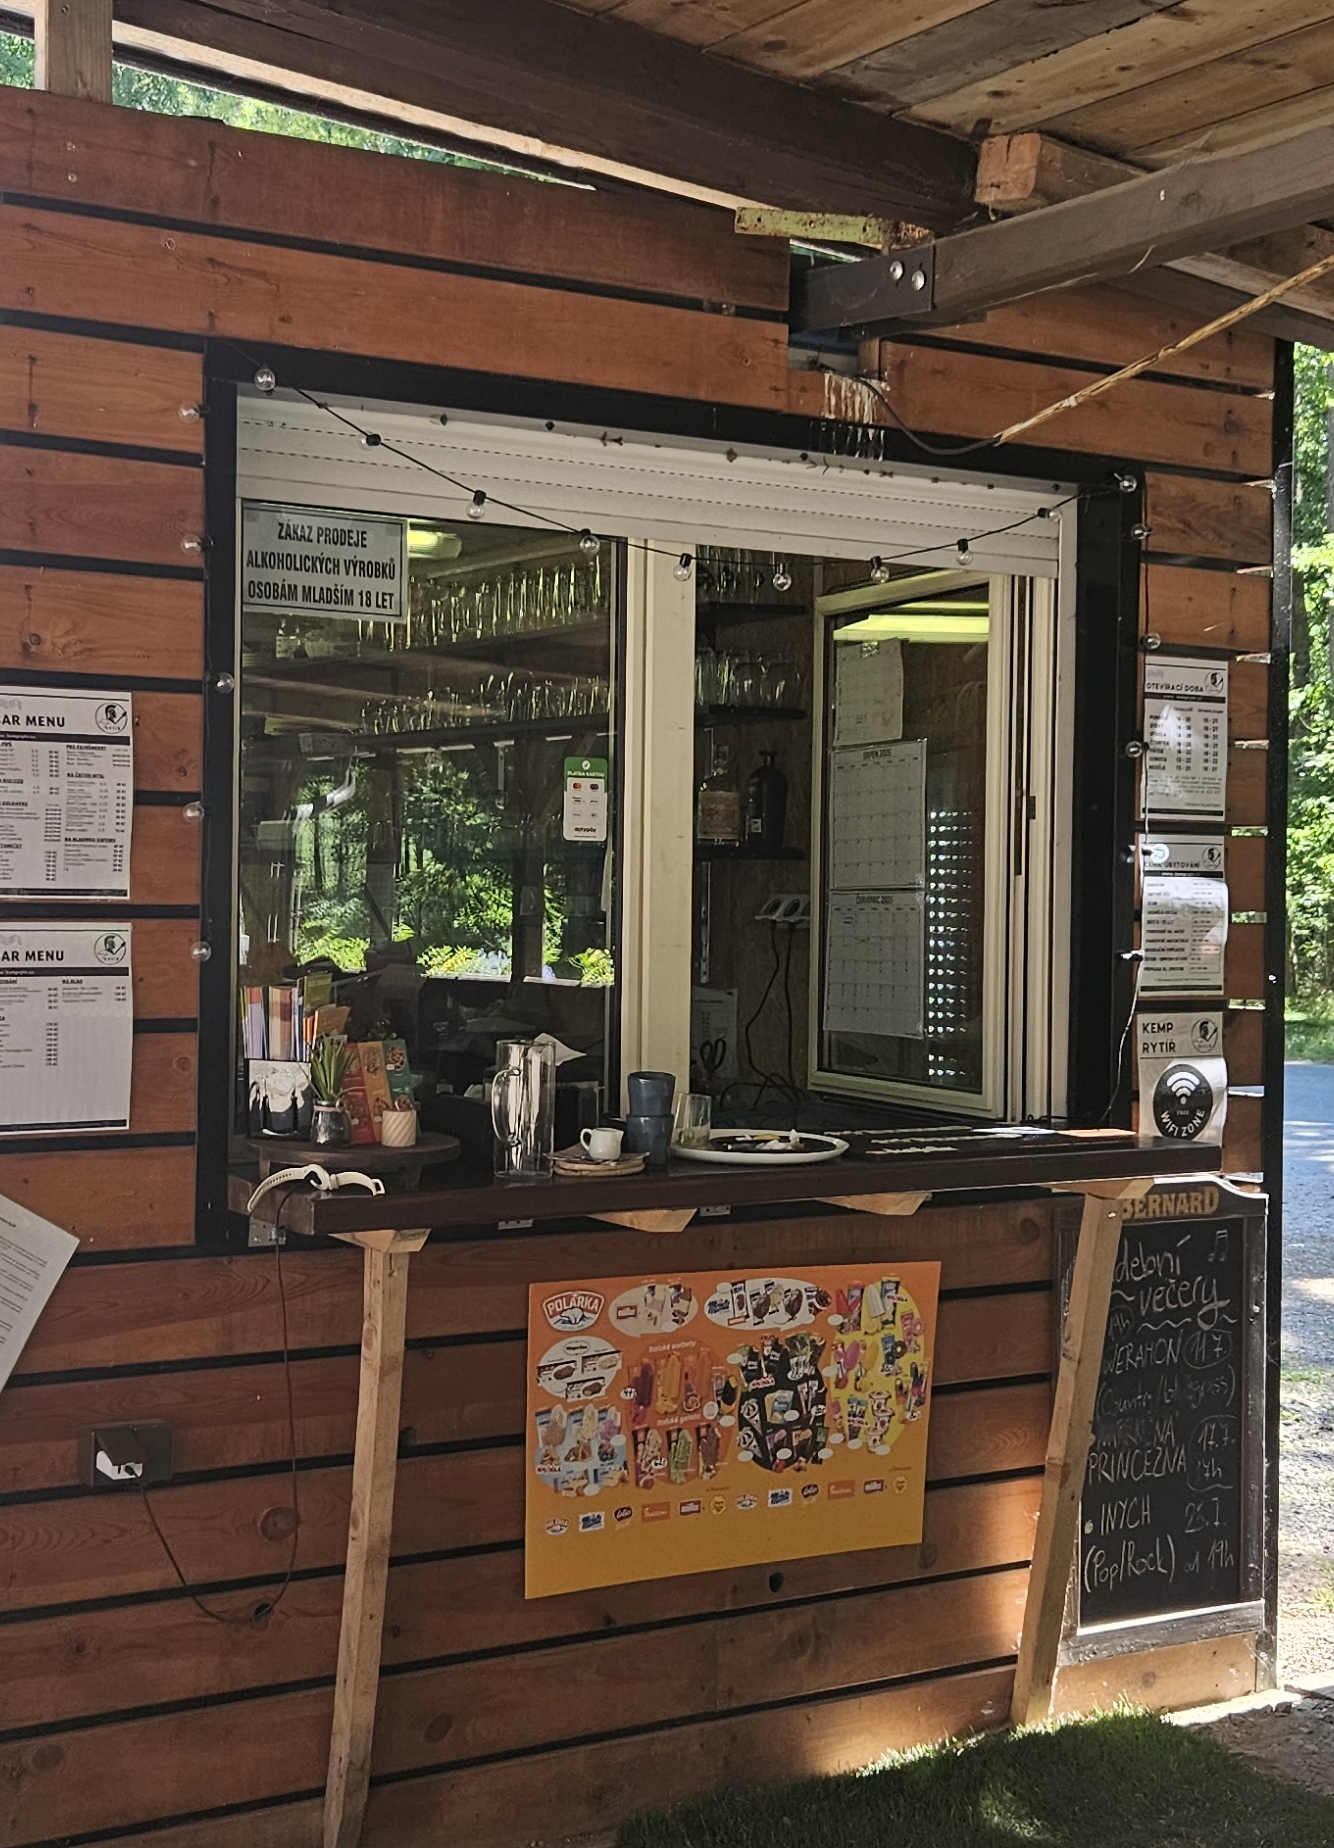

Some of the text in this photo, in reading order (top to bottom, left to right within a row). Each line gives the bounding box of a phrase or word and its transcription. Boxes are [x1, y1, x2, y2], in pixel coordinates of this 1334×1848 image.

[278, 519, 367, 548] ZÁKAZ PRODEJE
[246, 550, 395, 580] ALKOHOLICKÝCH VÝROBKŮ
[248, 579, 394, 610] OSOBÁM MLADŠÍM 18 LET
[1184, 684, 1203, 692] DOBA
[25, 715, 65, 728] MENU
[24, 951, 65, 962] MENU
[1142, 1022, 1174, 1034] KEMP
[1142, 1038, 1177, 1054] RYTÍŘ
[1160, 1108, 1205, 1137] WIFI ZONE
[1120, 1185, 1220, 1220] BERNARD
[1112, 1234, 1192, 1283] dební
[546, 1293, 599, 1316] POLÁRKA
[1139, 1275, 1231, 1331] večery
[1088, 1444, 1188, 1486] PRINCEZNA
